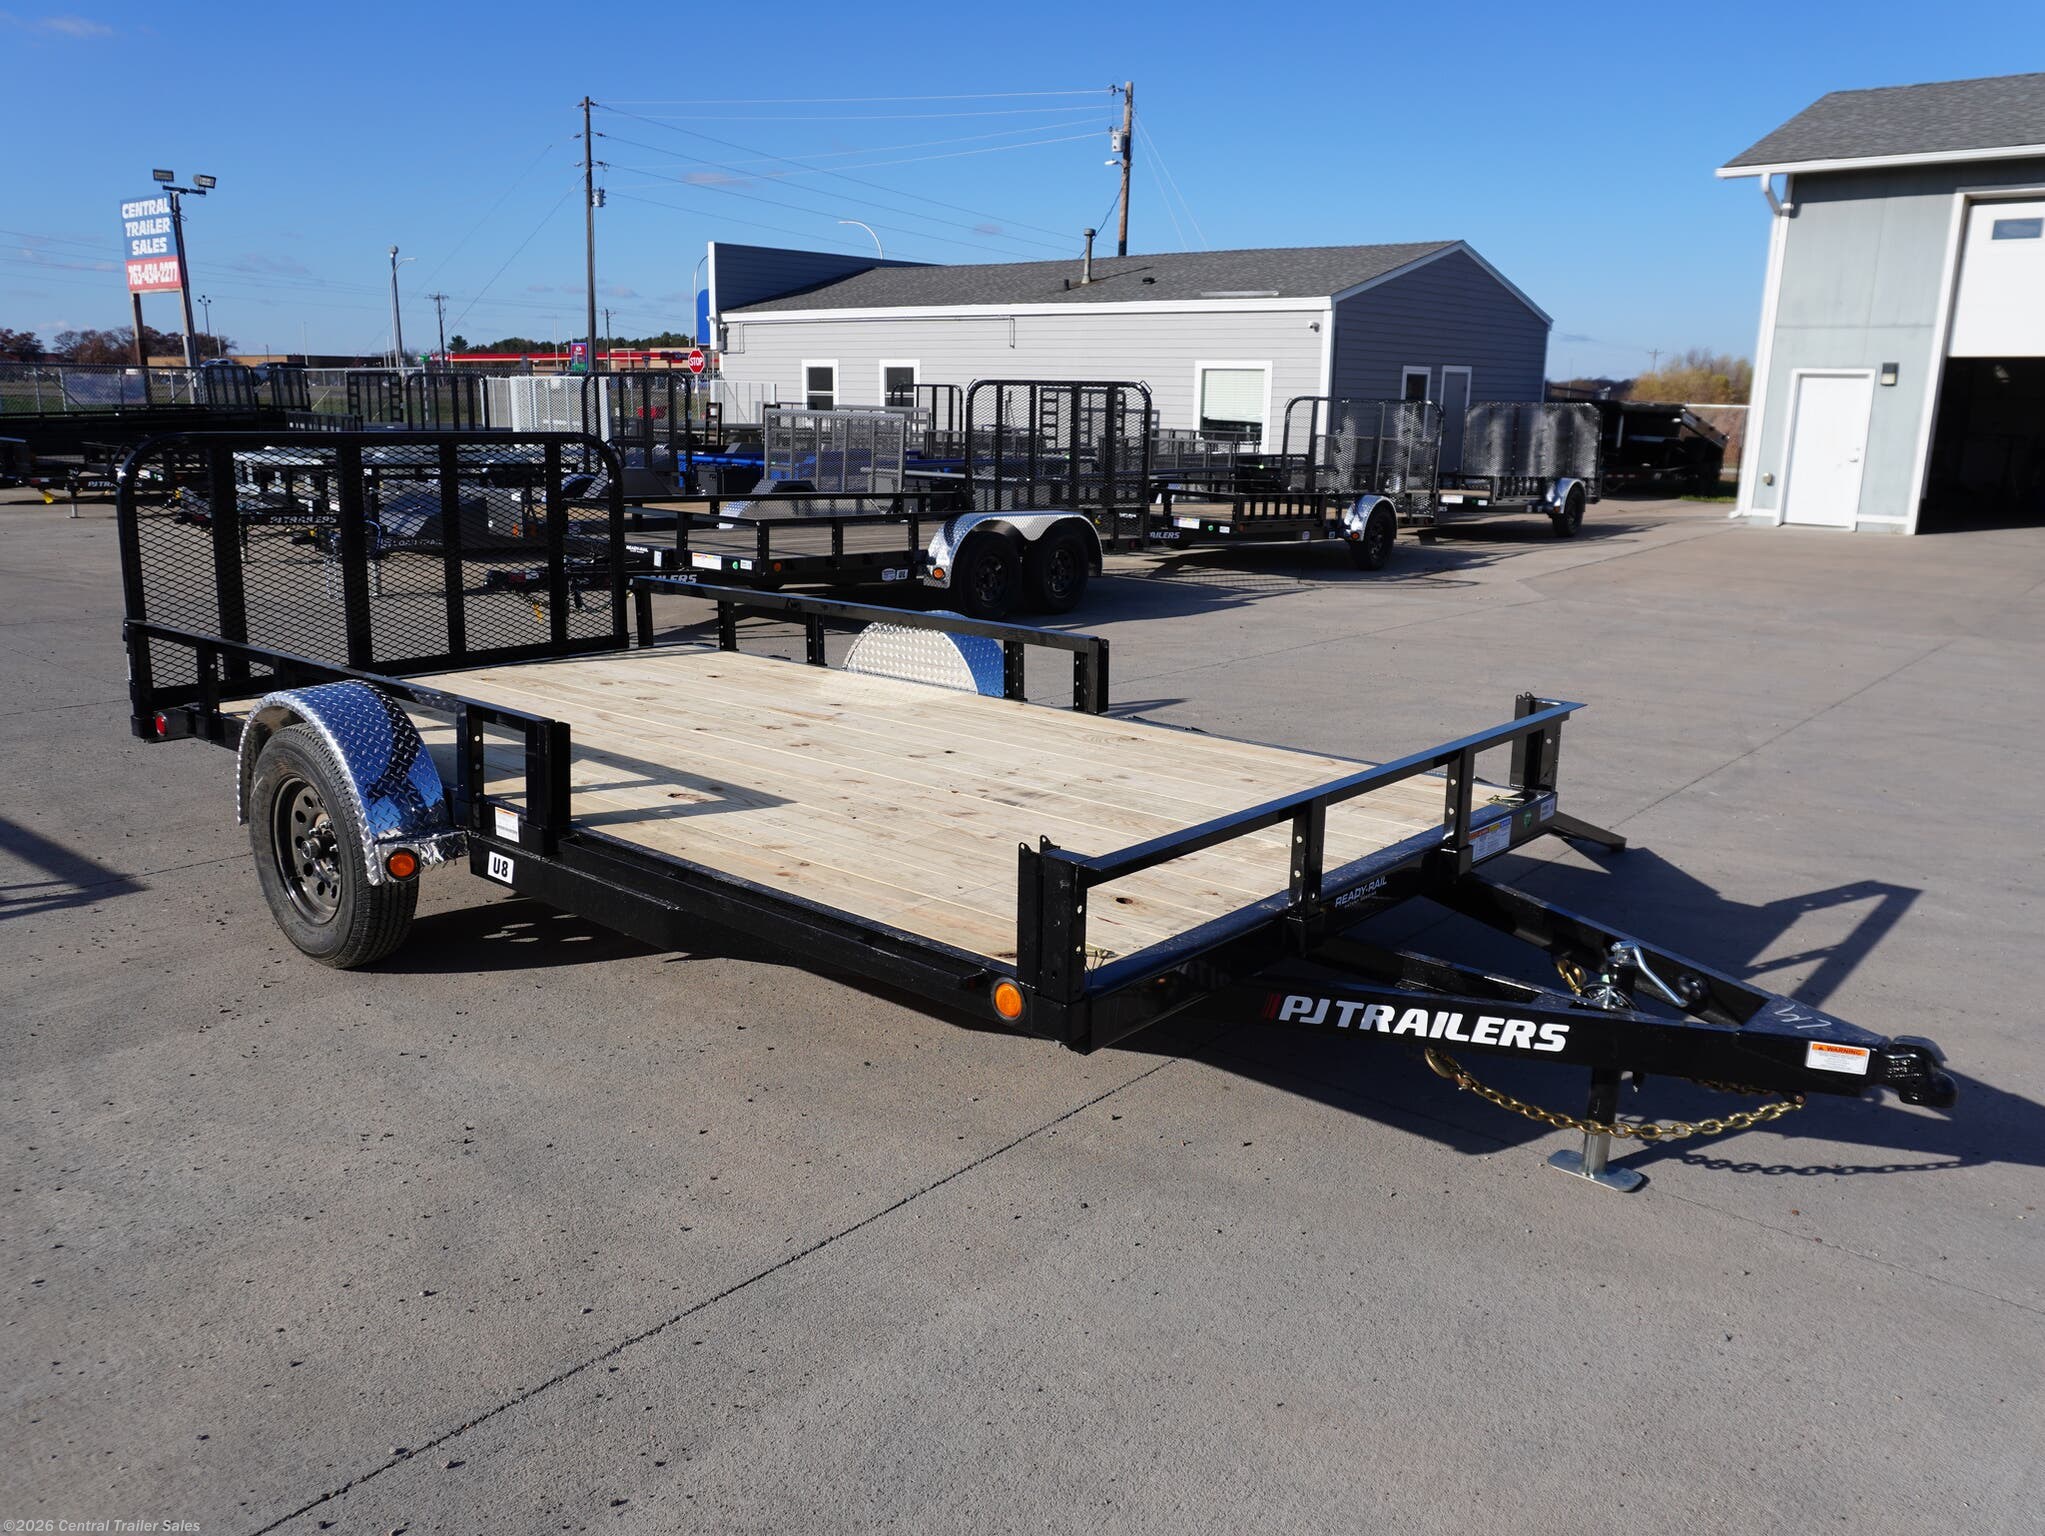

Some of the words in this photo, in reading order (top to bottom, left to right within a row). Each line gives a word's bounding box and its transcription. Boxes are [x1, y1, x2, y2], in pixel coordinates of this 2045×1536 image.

[122, 198, 170, 219] CENTRAL
[125, 217, 170, 237] TRAILER
[132, 238, 167, 256] SALES
[690, 356, 703, 366] STOP
[493, 857, 509, 878] U8
[1279, 995, 1330, 1025] PJ
[1335, 1000, 1570, 1052] TRAILERS
[1826, 1045, 1862, 1055] WARNING
